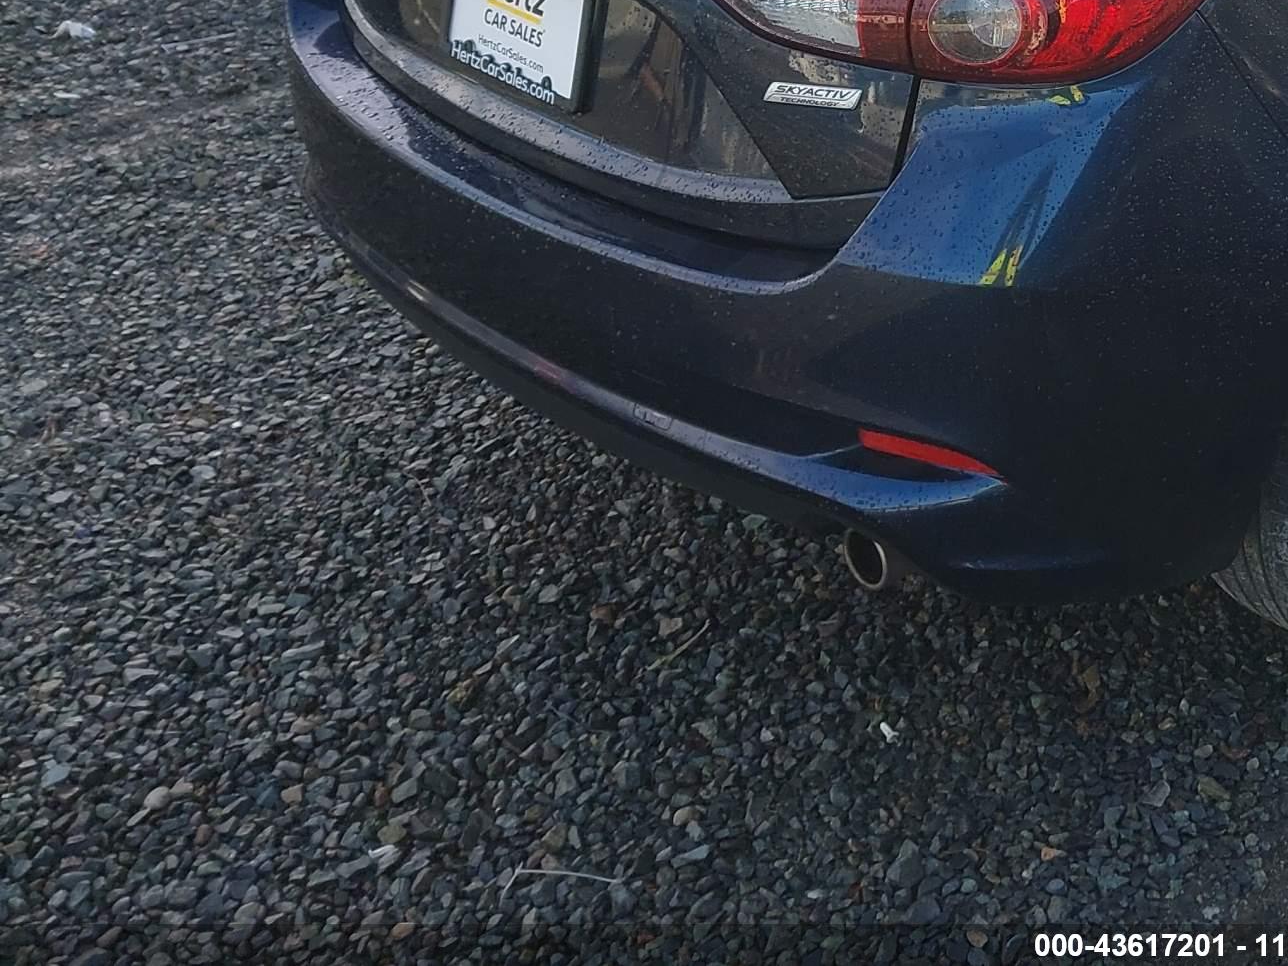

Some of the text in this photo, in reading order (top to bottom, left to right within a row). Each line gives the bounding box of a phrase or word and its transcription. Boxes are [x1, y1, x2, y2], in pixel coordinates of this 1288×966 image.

[483, 8, 544, 48] CAR SALES
[478, 34, 544, 73] HertzCarSales.com
[451, 43, 555, 105] HertzCarSales.com
[774, 84, 852, 99] SKYACTIV
[780, 96, 841, 107] TECHNOLOGY
